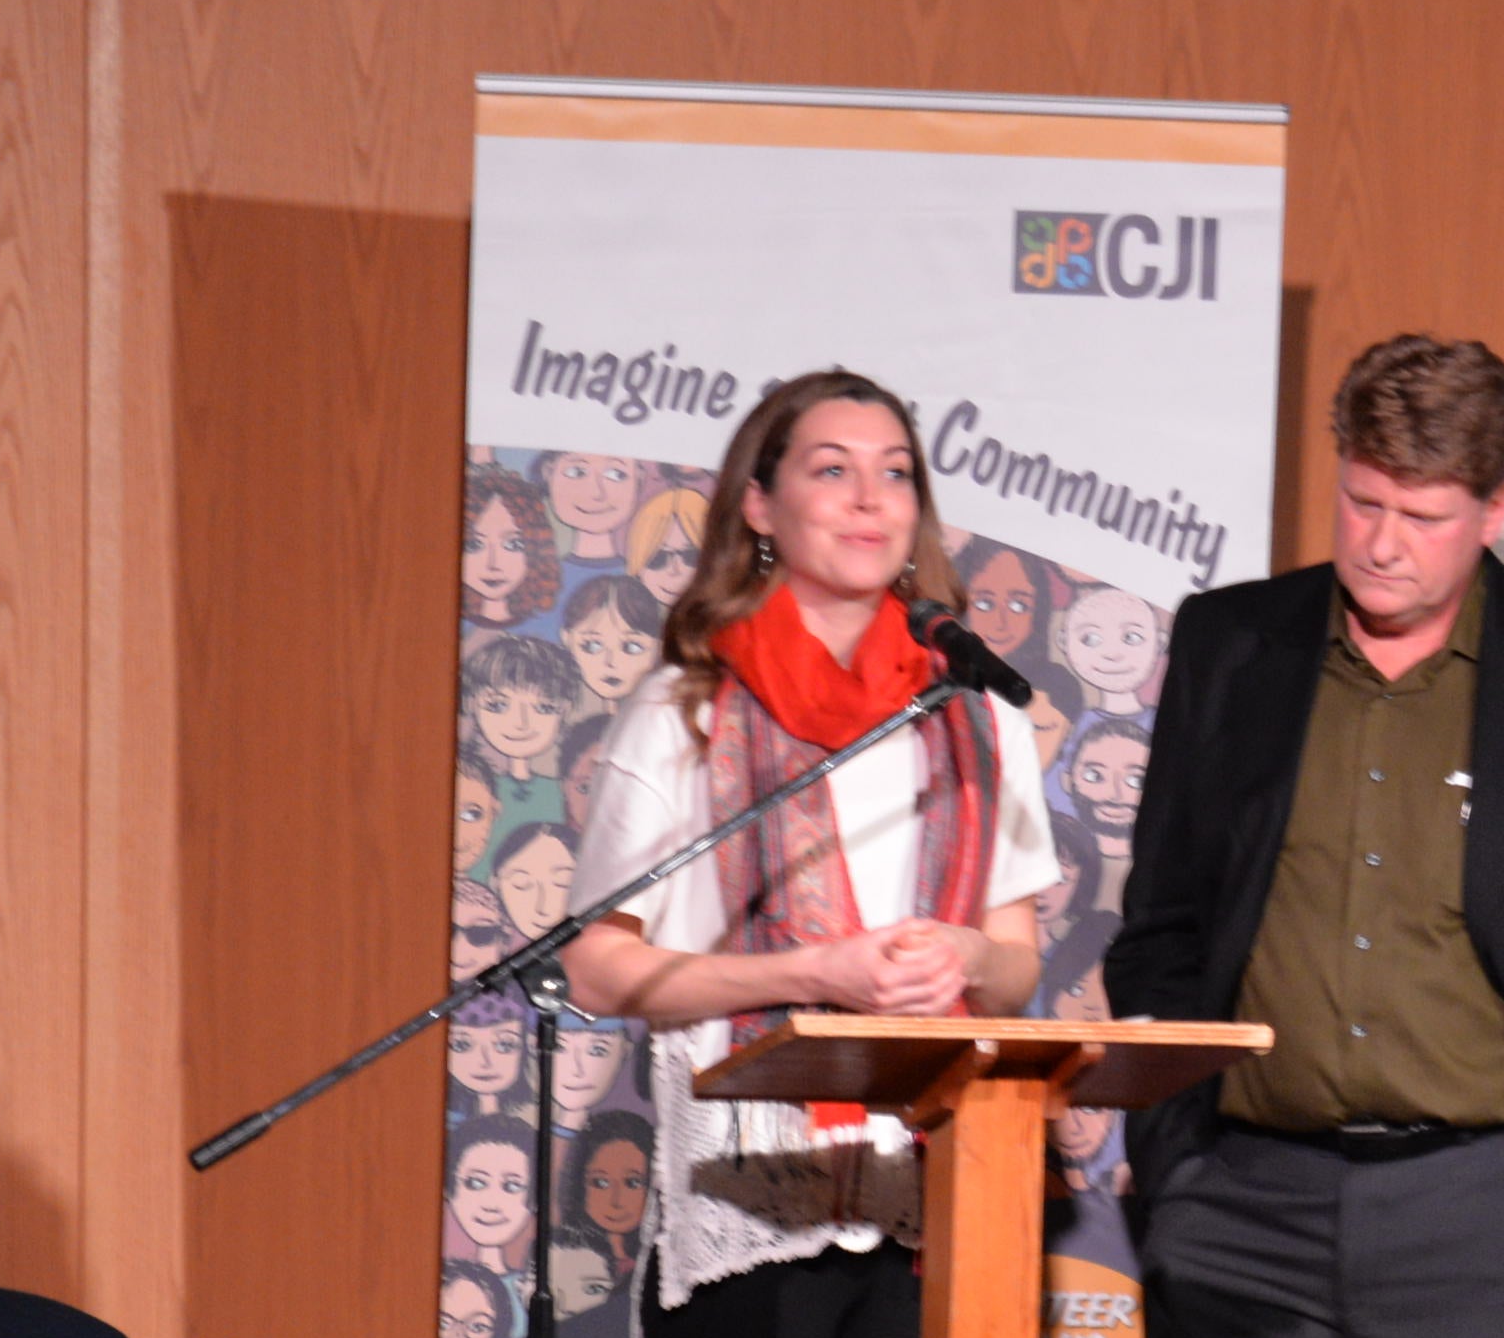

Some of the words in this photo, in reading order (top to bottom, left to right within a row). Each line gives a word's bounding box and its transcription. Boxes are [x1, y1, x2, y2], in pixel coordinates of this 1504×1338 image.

[1106, 213, 1219, 300] CJI
[512, 319, 737, 425] Imagine
[931, 399, 1226, 589] Community
[1045, 1290, 1137, 1328] TEER
